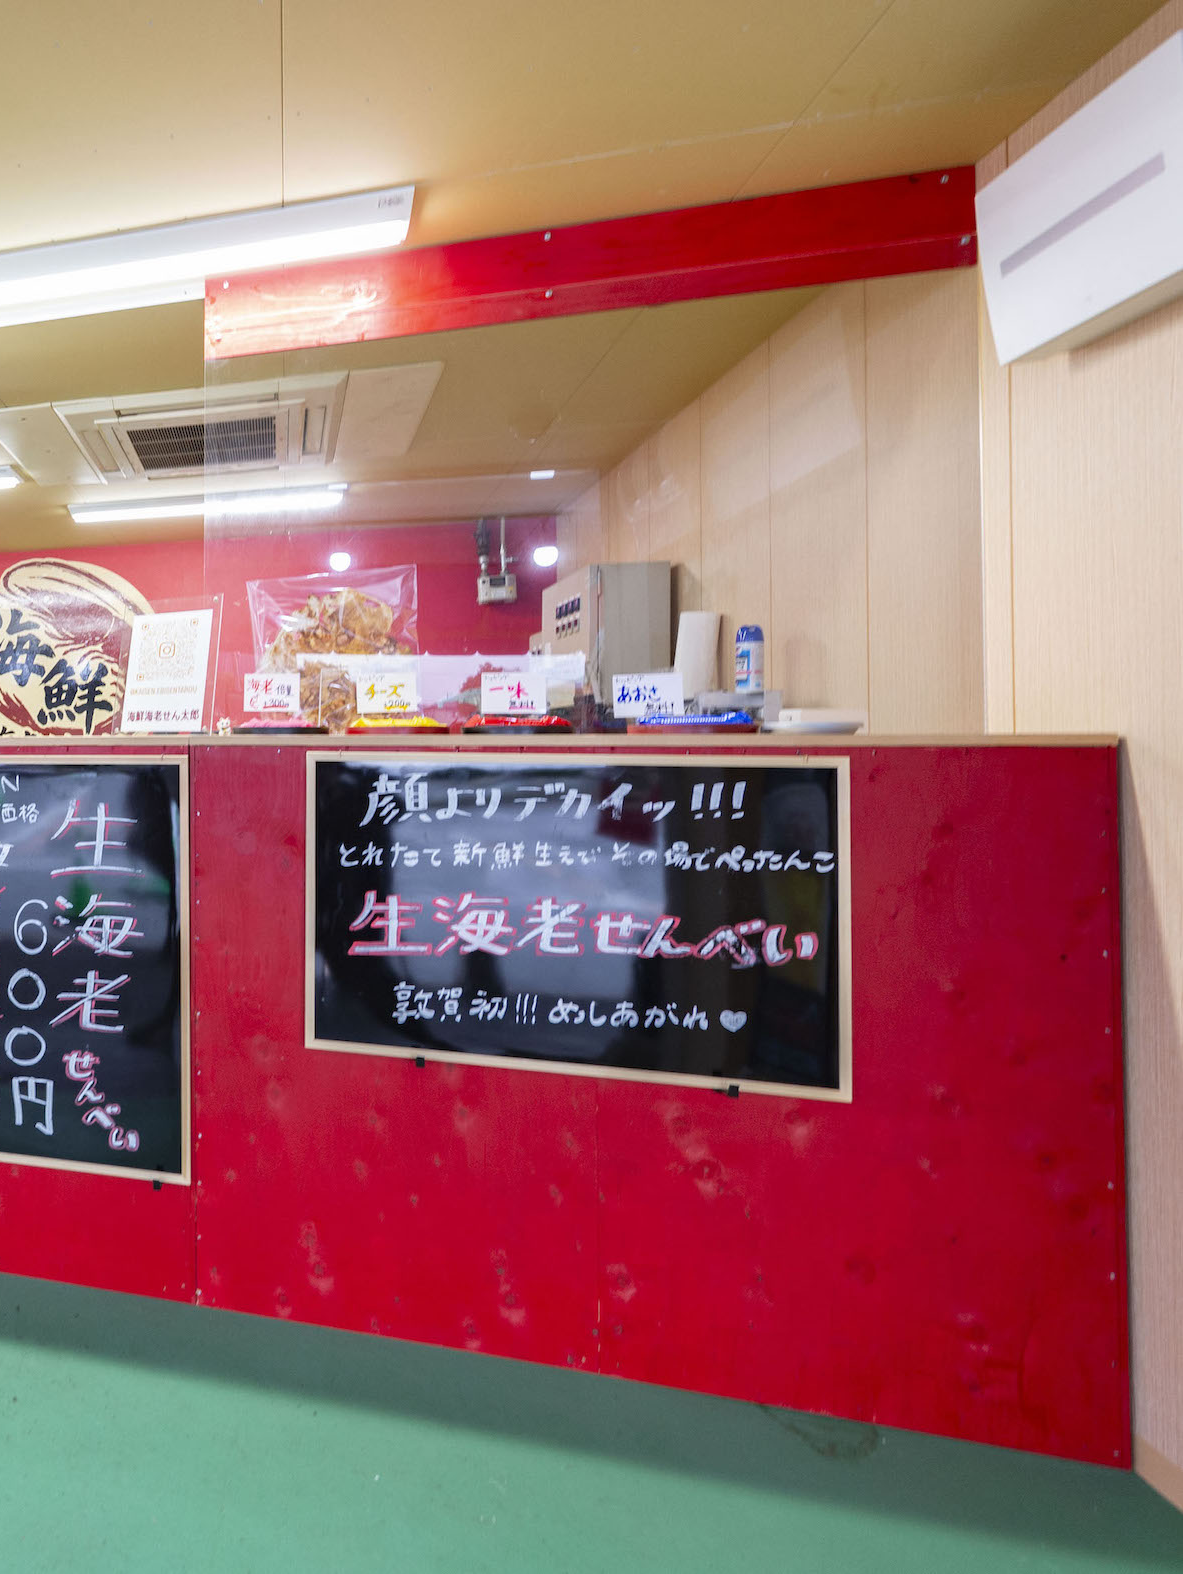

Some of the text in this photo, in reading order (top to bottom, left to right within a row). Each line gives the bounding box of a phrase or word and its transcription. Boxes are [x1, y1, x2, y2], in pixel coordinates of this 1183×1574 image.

[364, 683, 405, 701] チーズ
[489, 681, 529, 699] 一味
[617, 684, 661, 704] あおさ
[127, 709, 200, 722] 海鮮海老せん太郎
[348, 889, 819, 968] 生海老せんべい
